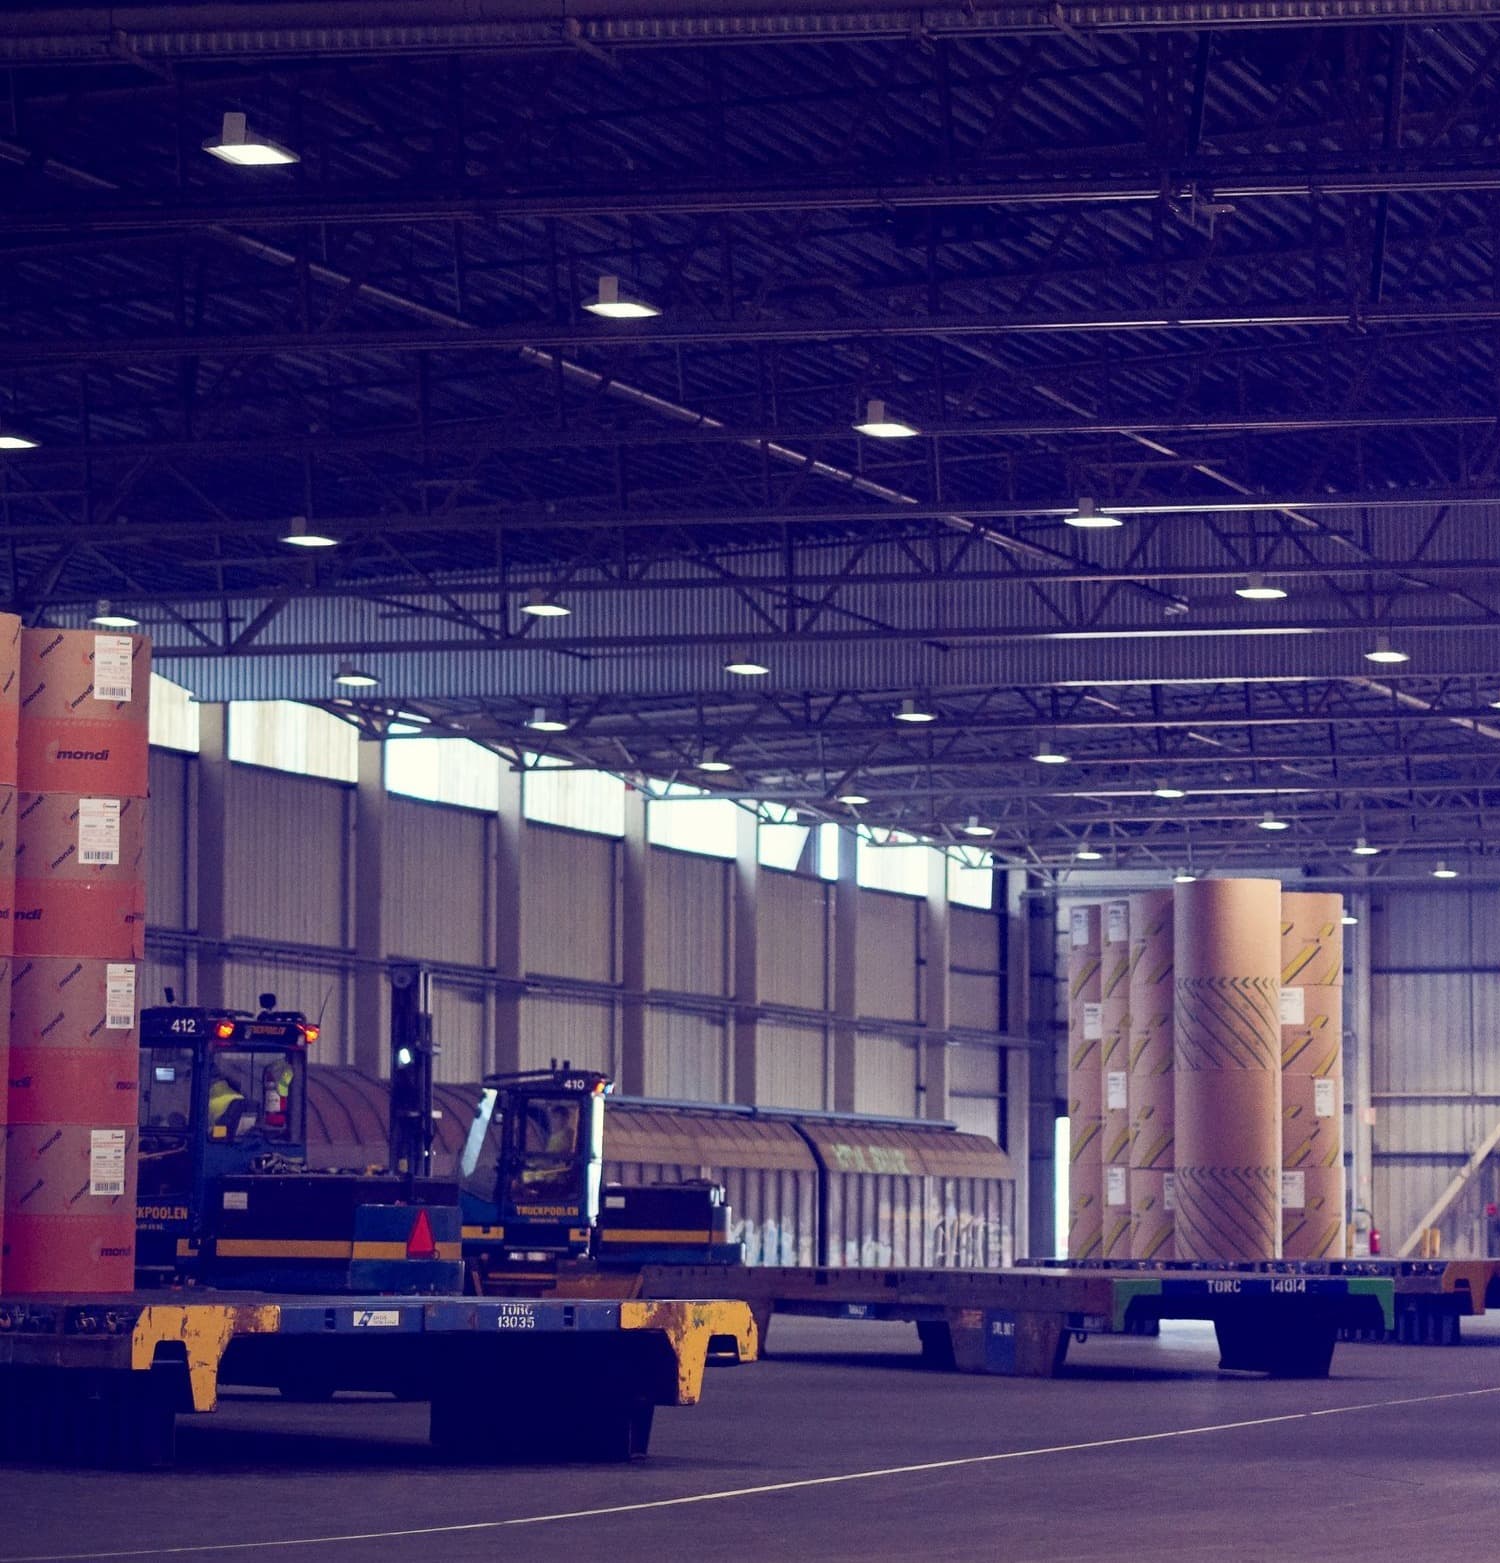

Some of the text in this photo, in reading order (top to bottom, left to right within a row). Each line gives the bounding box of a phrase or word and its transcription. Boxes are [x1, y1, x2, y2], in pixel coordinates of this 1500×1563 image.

[57, 750, 109, 761] mondi
[171, 1018, 196, 1033] 412
[564, 1079, 585, 1090] 410
[1207, 1278, 1306, 1293] TORC 14014
[502, 1303, 533, 1315] TORC
[497, 1316, 535, 1329] 13035
